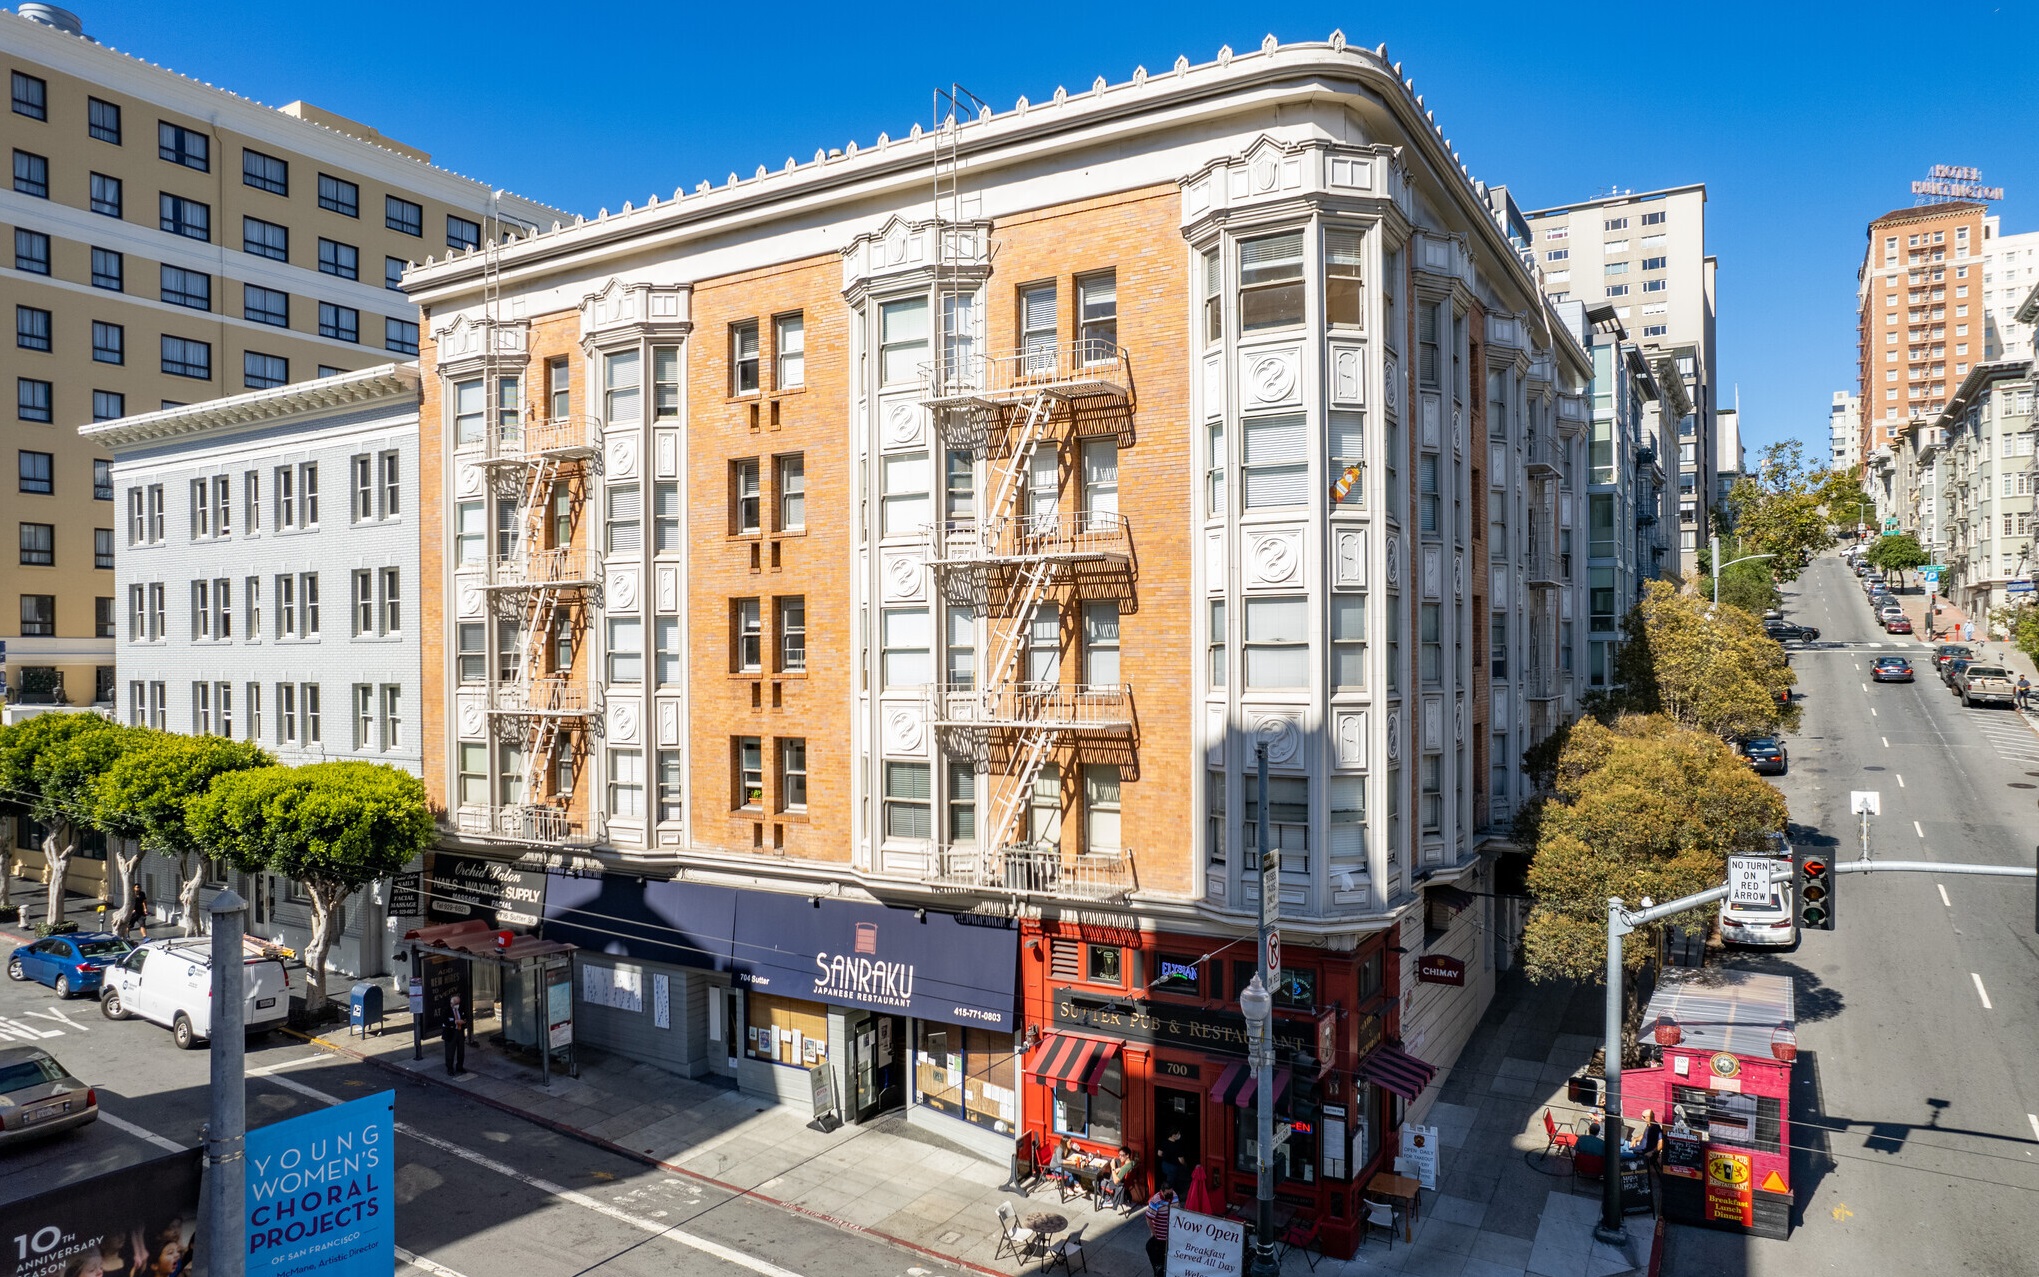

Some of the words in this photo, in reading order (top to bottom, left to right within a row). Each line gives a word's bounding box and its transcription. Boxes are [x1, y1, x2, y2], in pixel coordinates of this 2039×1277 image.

[1935, 164, 1979, 180] HOTEL
[1911, 181, 2004, 200] HUNTINGTON
[455, 861, 488, 878] Orchid
[490, 865, 522, 884] Salon
[1732, 861, 1743, 869] NO
[1747, 862, 1768, 870] TURN
[433, 877, 459, 890] NAILS
[465, 880, 500, 896] WAXING
[505, 886, 541, 903] SUPPLY
[1734, 891, 1766, 900] ARROW
[452, 893, 480, 904] MASSAGE
[491, 899, 513, 910] FACIAL
[509, 914, 527, 922] Sutter
[740, 973, 751, 982] 704
[751, 975, 770, 985] Sutter
[814, 952, 914, 999] SANRAKU
[1161, 961, 1198, 981] ELYSIAN
[1422, 967, 1459, 978] CHIMAY
[813, 986, 854, 1000] JAPANESE
[857, 992, 911, 1008] RESTAURANT
[953, 1007, 1002, 1023] 415-771-0803
[1130, 1012, 1161, 1030] PUB
[1169, 1019, 1181, 1034] &
[1190, 1020, 1305, 1051] RESTAUANT
[1167, 1063, 1188, 1076] 700
[254, 1124, 379, 1177] YOUNG
[252, 1147, 379, 1201] WOMEN'S
[1709, 1176, 1748, 1191] RESTAURANT
[251, 1173, 379, 1227] CHORAL
[1709, 1194, 1748, 1207] Breakfast
[1715, 1203, 1742, 1213] Lunch
[1714, 1210, 1743, 1221] Dinner
[250, 1196, 379, 1255] PROJECTS
[1173, 1216, 1202, 1233] Now
[1206, 1223, 1239, 1243] Open
[16, 1235, 104, 1273] ANNIVERSARY
[271, 1255, 285, 1265] OF
[288, 1248, 306, 1261] SAN
[309, 1231, 360, 1254] FRANCISCO
[318, 1252, 348, 1268] Artistic
[350, 1240, 379, 1258] Director
[1185, 1242, 1226, 1260] Breakfast
[1174, 1250, 1202, 1264] Served
[1203, 1257, 1215, 1267] All
[1217, 1262, 1235, 1273] Day
